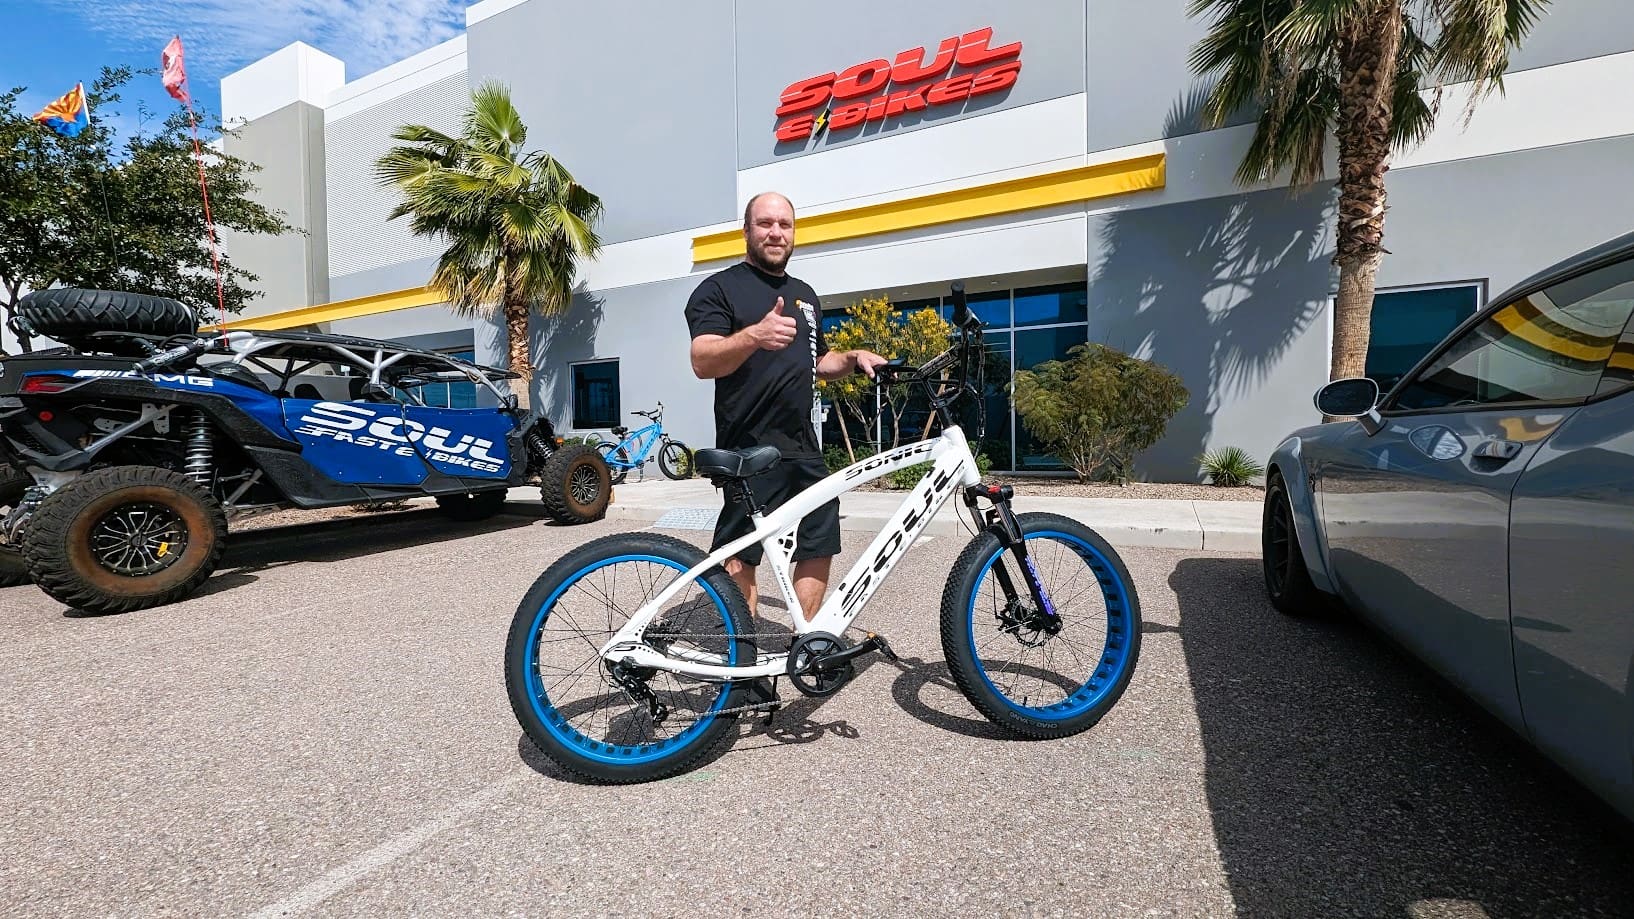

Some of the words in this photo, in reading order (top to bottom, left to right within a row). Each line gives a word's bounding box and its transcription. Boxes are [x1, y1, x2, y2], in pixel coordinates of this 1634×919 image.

[776, 26, 1022, 118] SOUL
[300, 401, 504, 465] SOUL
[432, 452, 501, 473] BIKES
[845, 442, 934, 481] SONIC
[838, 459, 964, 618] SOUL
